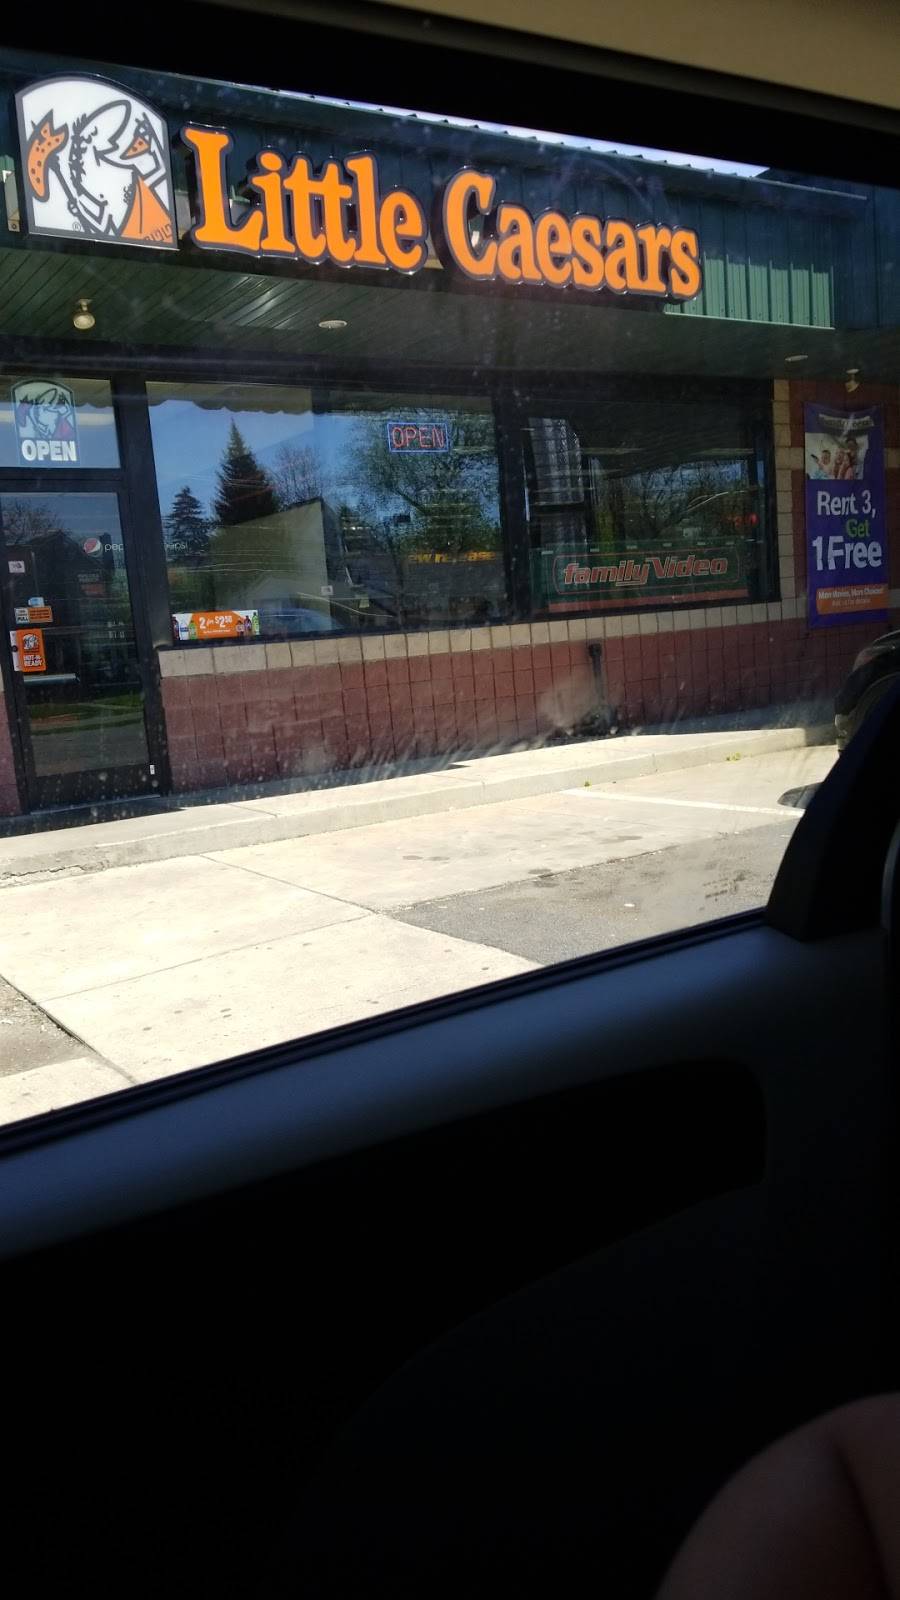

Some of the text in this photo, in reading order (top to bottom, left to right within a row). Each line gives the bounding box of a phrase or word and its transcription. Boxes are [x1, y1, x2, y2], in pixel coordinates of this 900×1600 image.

[185, 128, 701, 297] Little Caesars
[391, 425, 446, 449] OPEN
[21, 439, 78, 462] OPEN
[817, 489, 877, 518] Rent 3,
[845, 518, 871, 538] Get
[812, 535, 883, 571] 1 Free
[199, 617, 206, 629] 2
